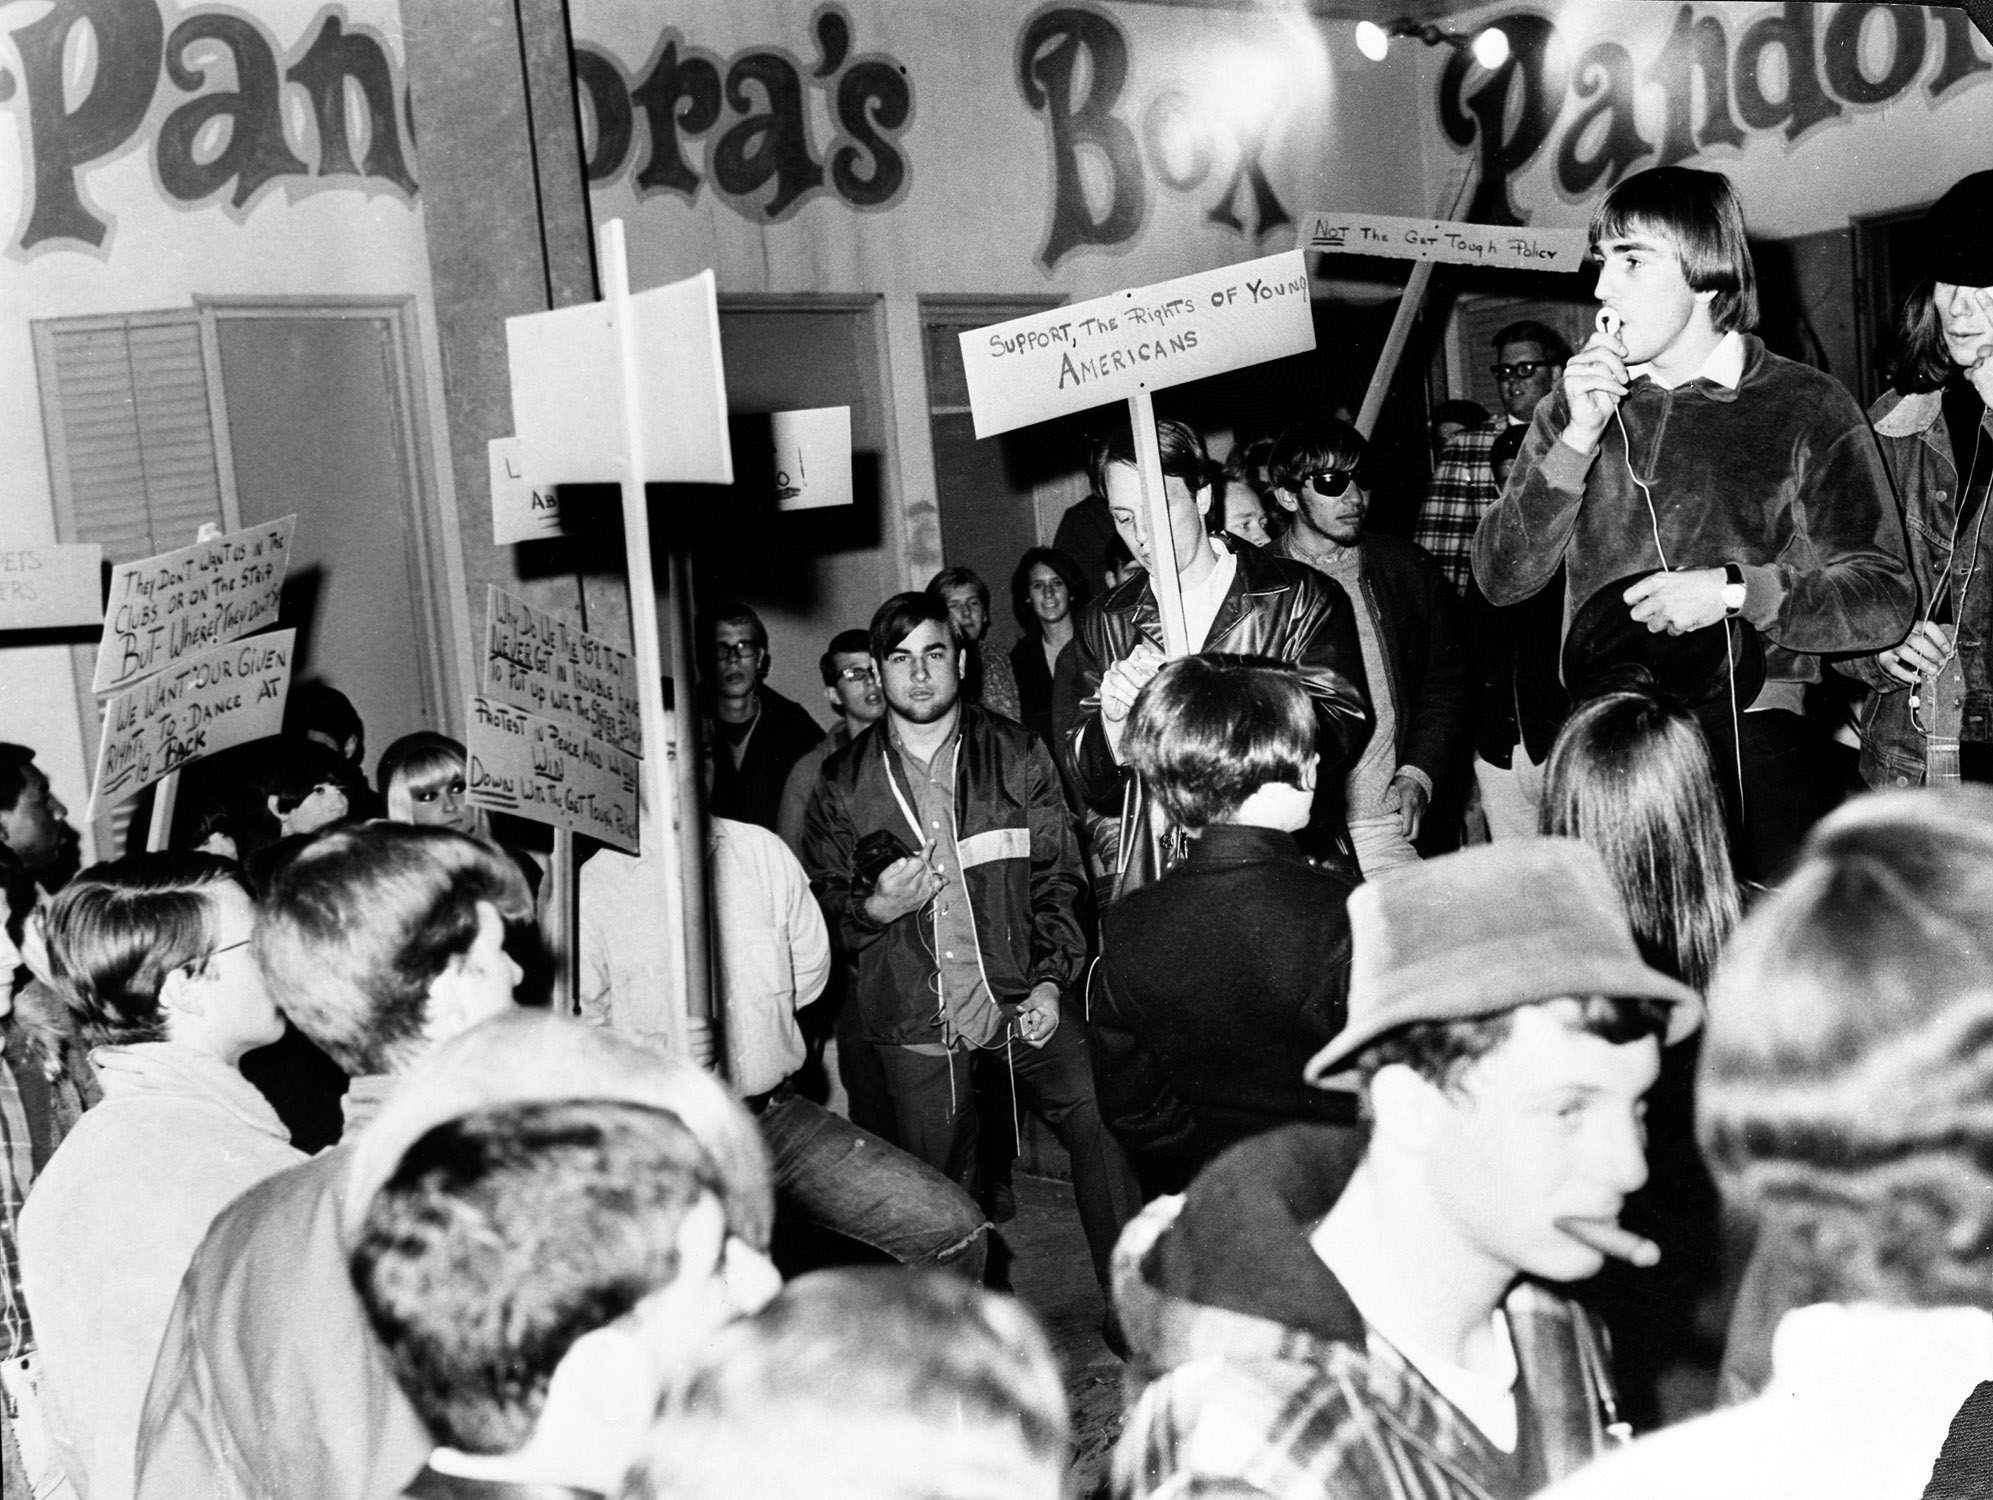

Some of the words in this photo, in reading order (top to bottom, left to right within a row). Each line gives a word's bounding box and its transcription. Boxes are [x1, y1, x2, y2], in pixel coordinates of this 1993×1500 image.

[0, 0, 911, 252] Panora's
[1445, 233, 1498, 258] Tough
[1057, 330, 1199, 390] AMERICANS
[0, 550, 42, 572] ETS
[189, 695, 242, 733] DANCE
[257, 678, 281, 704] AT
